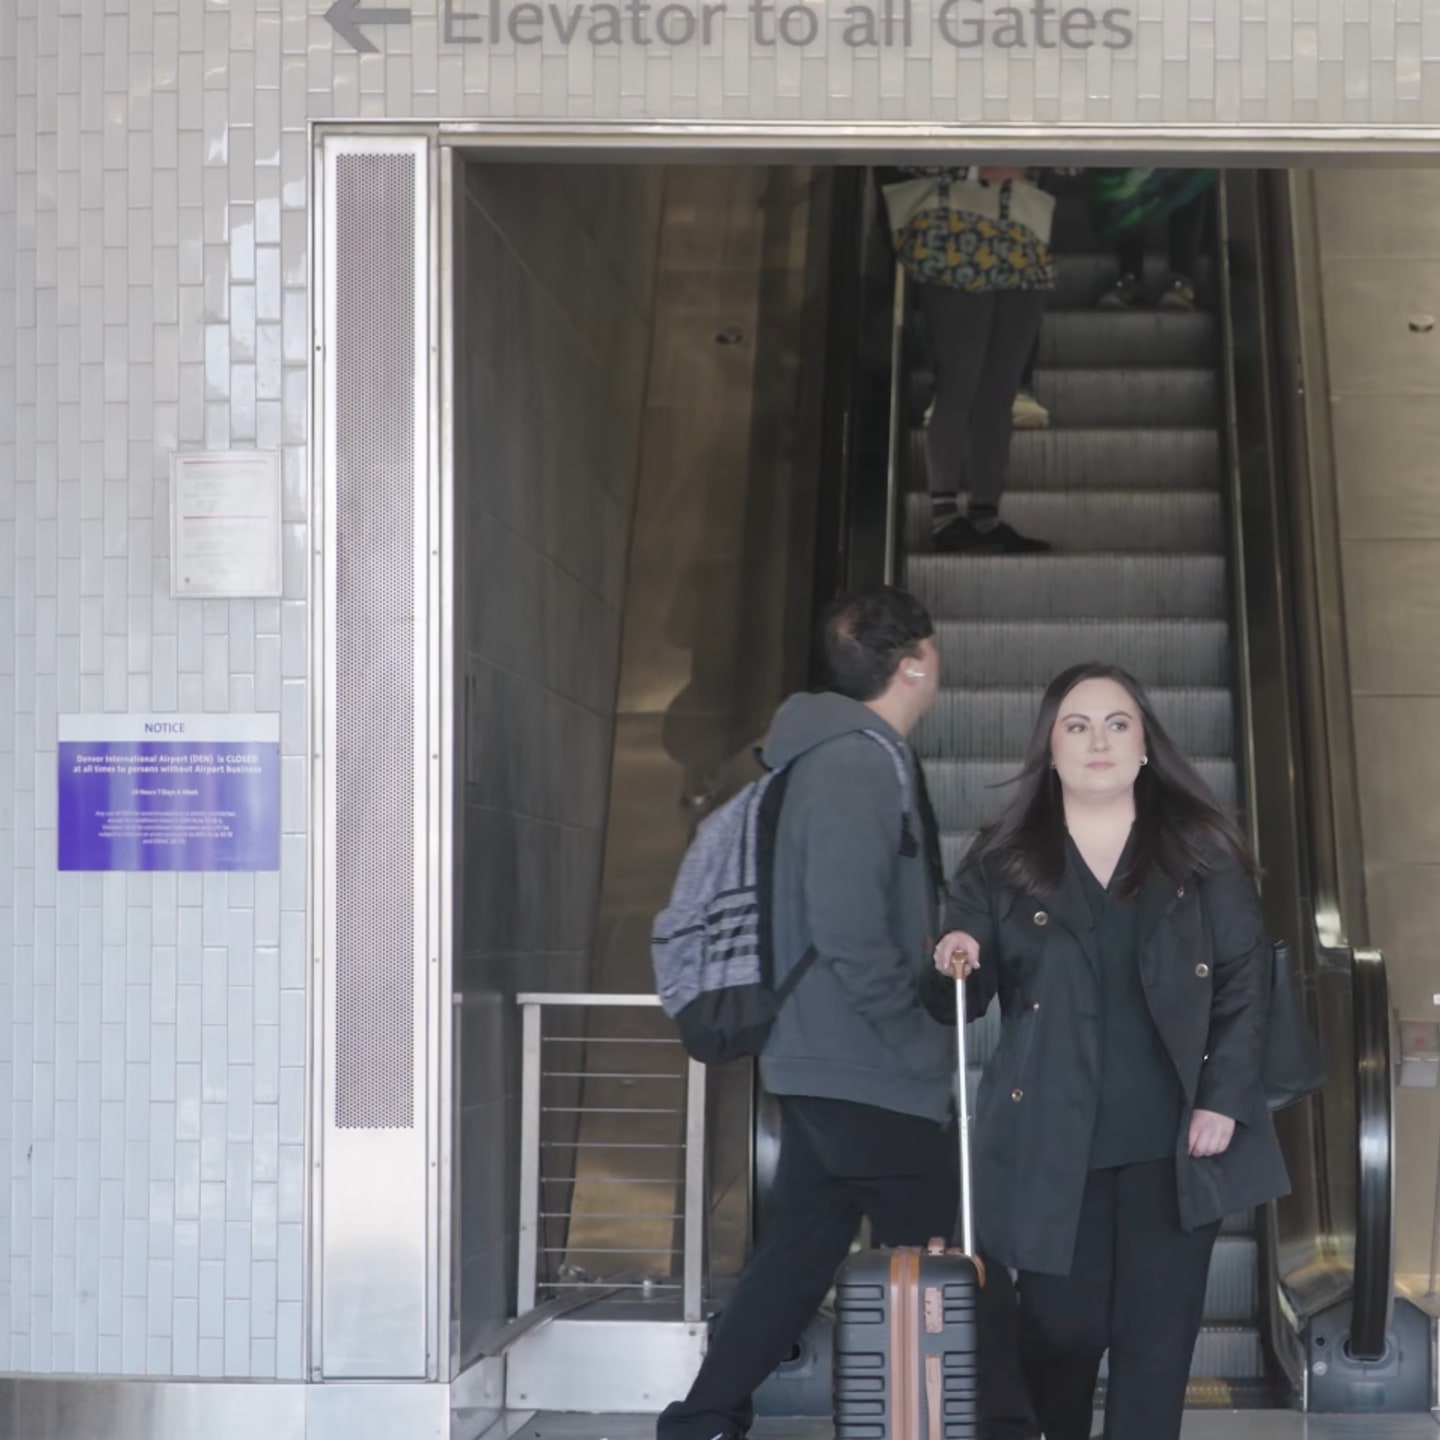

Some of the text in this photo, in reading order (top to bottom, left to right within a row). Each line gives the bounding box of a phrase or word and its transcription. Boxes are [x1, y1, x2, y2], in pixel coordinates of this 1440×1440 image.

[442, 0, 1135, 51] Elevator to all Gates
[144, 722, 185, 733] NOTICE
[76, 754, 258, 765] Denver International Airport (DEN) is CLOSED
[73, 764, 262, 775] at all times to persons without Airport business
